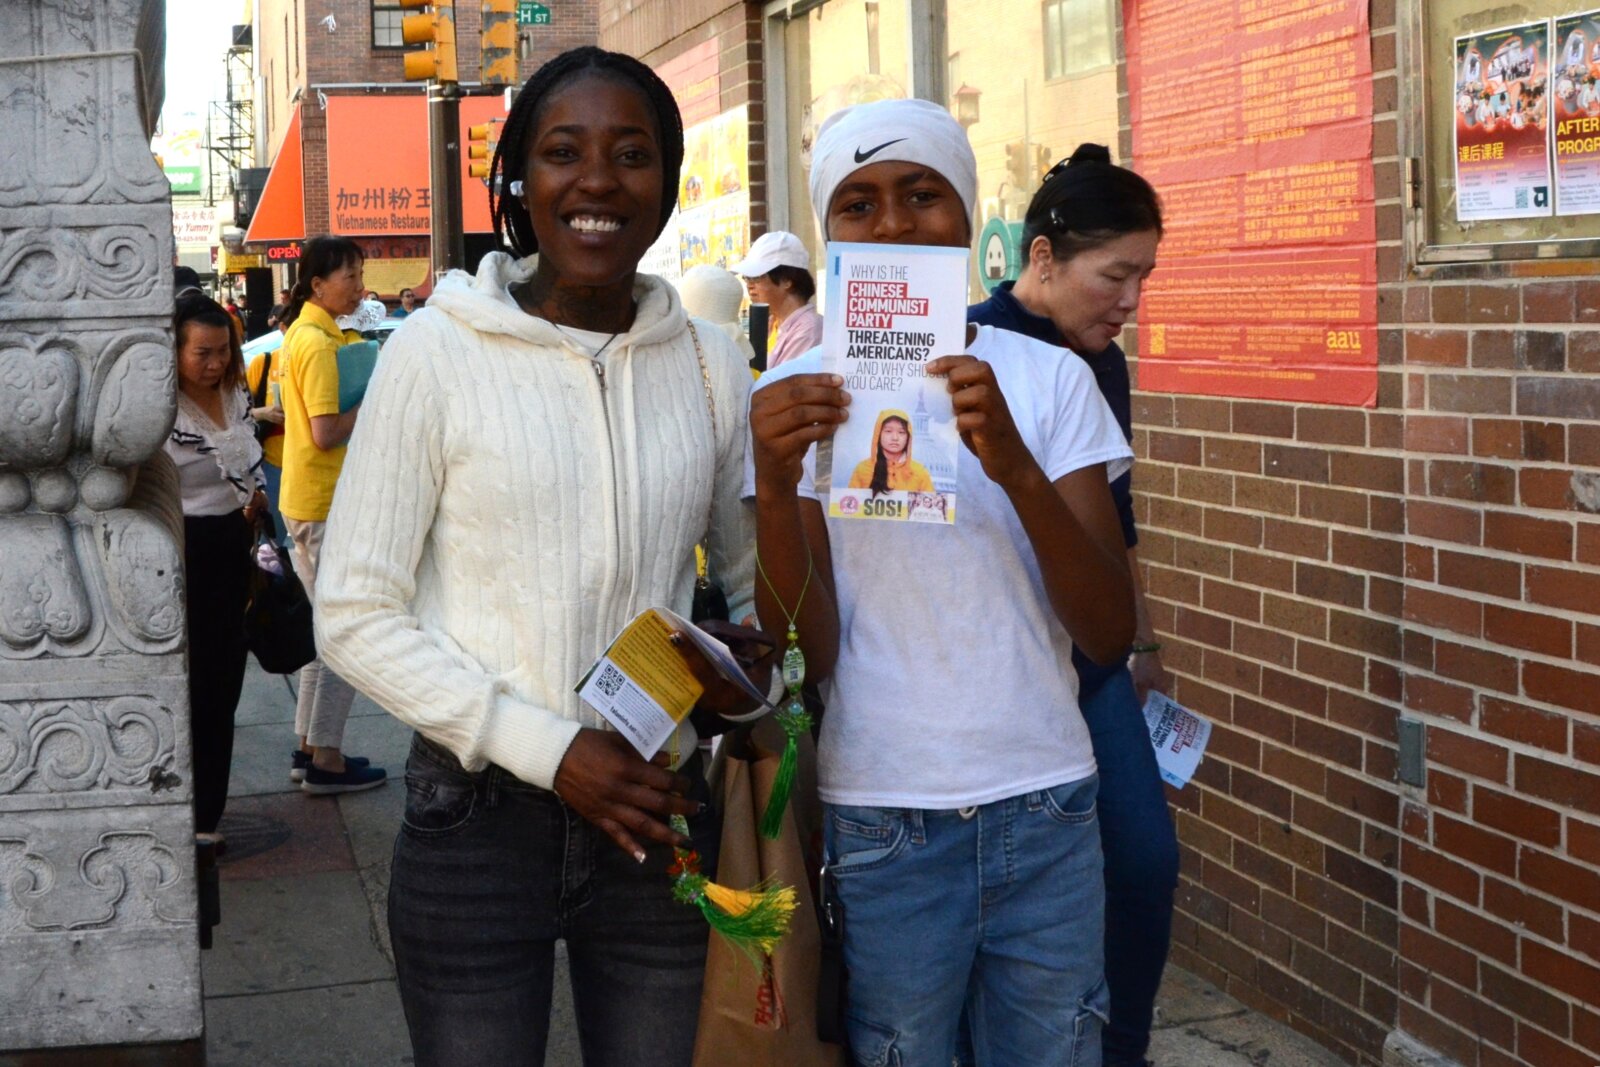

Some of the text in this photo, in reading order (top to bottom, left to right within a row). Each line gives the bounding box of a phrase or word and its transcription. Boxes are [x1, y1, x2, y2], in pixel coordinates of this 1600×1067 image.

[535, 13, 548, 23] ST
[1557, 117, 1600, 136] AFTER
[1458, 142, 1505, 163] 课后课程
[185, 222, 214, 235] Yummy
[336, 214, 388, 230] Vietnamese
[268, 247, 301, 259] OPEN
[851, 264, 909, 281] WHY IS THE
[849, 283, 905, 299] CHINESE
[849, 298, 927, 315] COMMUNIST
[848, 313, 891, 328] PARTY
[848, 330, 936, 347] THREATENING
[1326, 330, 1362, 349] aau
[847, 344, 930, 362] AMERICANS?
[856, 361, 879, 376] AND
[881, 362, 906, 376] WHY
[846, 375, 903, 391] YOU CARE?
[863, 498, 902, 517] SOS!
